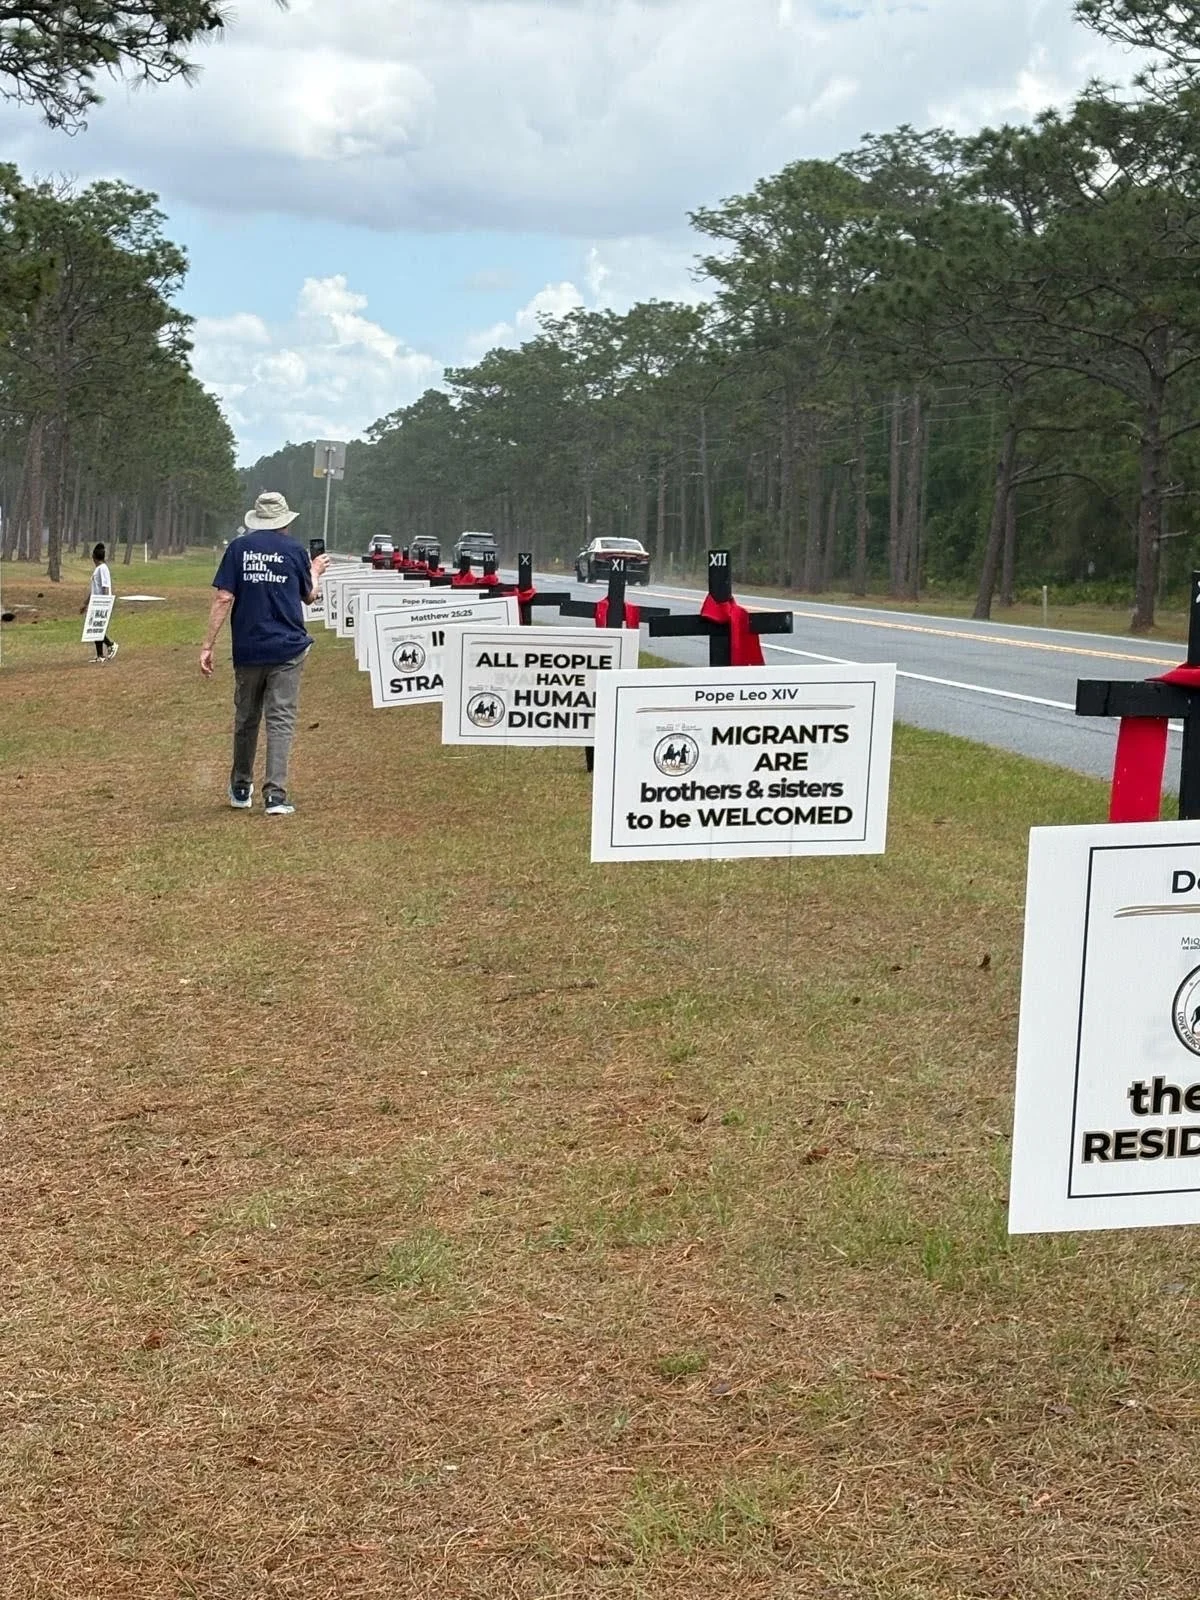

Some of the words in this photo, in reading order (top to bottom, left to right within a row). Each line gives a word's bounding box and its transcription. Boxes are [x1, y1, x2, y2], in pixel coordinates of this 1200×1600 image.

[243, 550, 285, 563] historic
[485, 553, 496, 562] IX
[520, 555, 530, 566] X
[709, 553, 727, 567] XII
[612, 558, 624, 572] XI
[243, 570, 288, 584] together
[411, 612, 449, 622] Matthew
[476, 652, 518, 668] ALL
[525, 653, 612, 670] PEOPLE
[536, 673, 586, 686] HAVE
[514, 690, 596, 708] HUMA
[694, 689, 735, 704] Pope
[740, 689, 767, 701] Leo
[771, 688, 799, 700] XIV
[711, 724, 849, 746] MIGRANTS
[753, 752, 808, 772] ARE
[640, 781, 741, 803] brothers
[745, 780, 764, 798] &
[768, 778, 843, 798] sisters
[626, 812, 653, 830] to
[660, 809, 691, 829] be
[697, 806, 853, 828] WELCOMED
